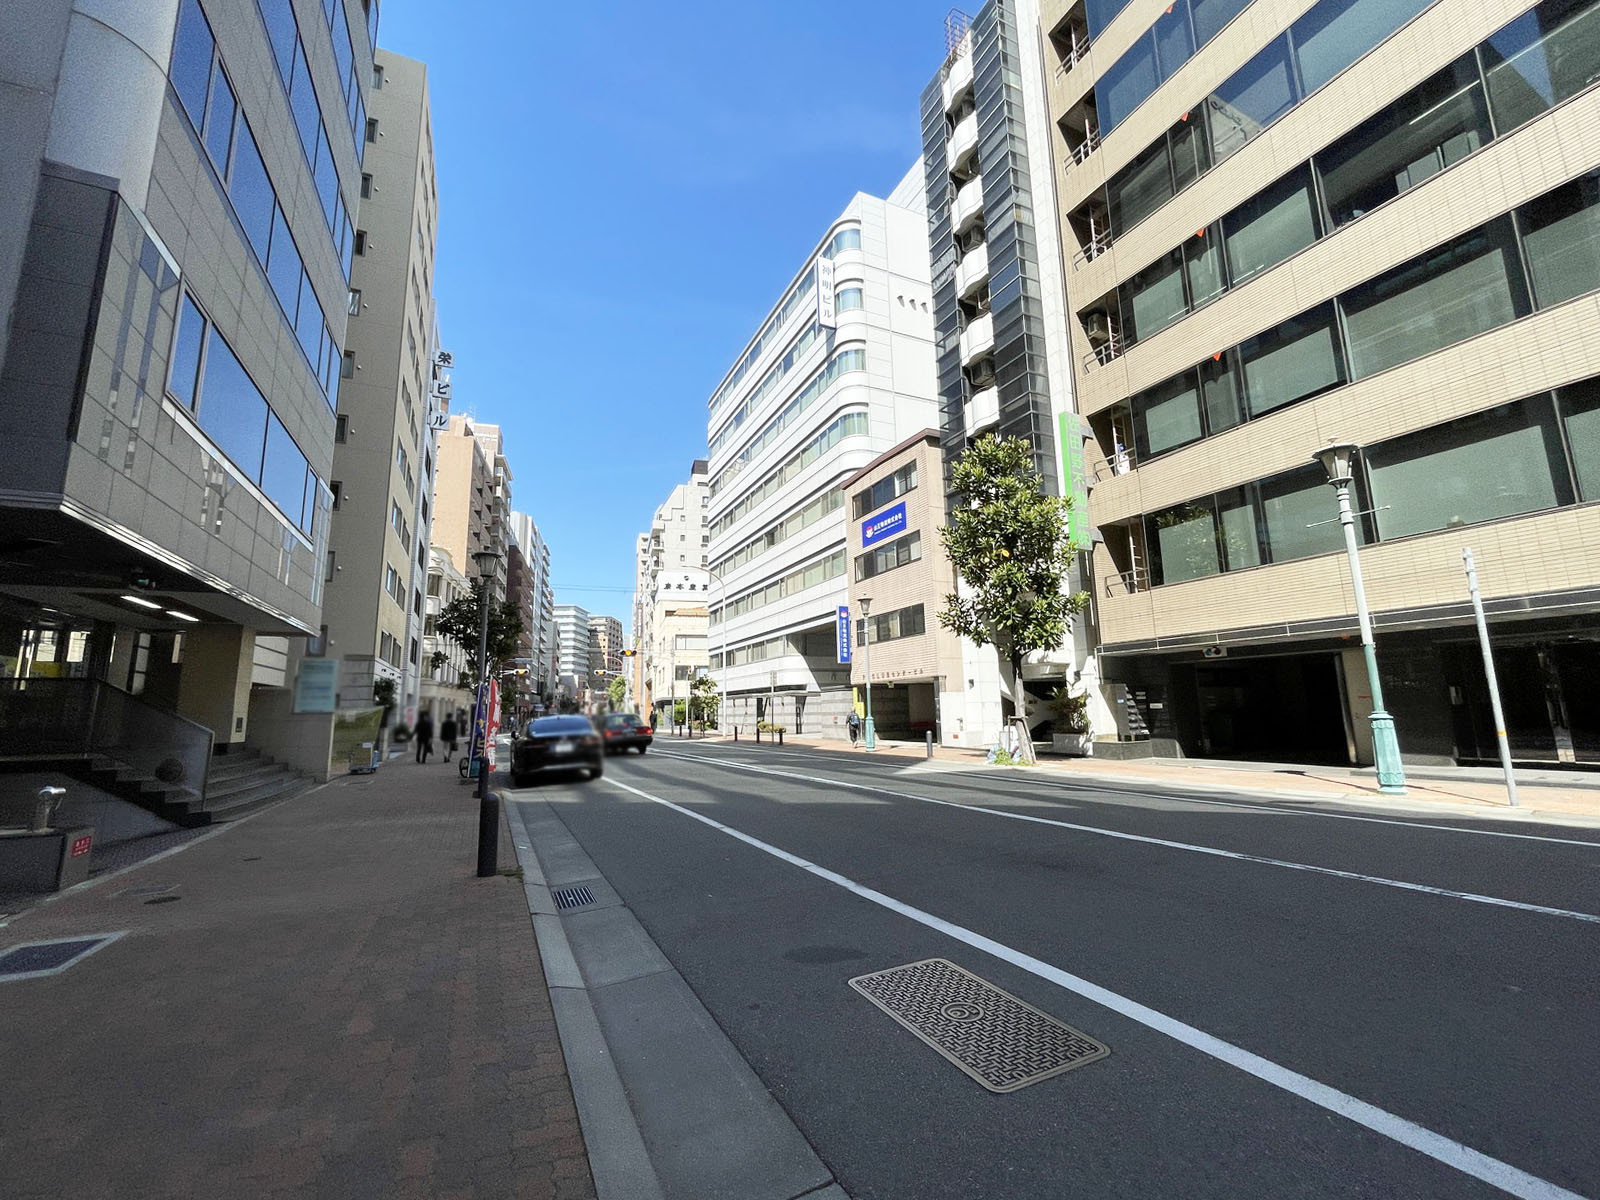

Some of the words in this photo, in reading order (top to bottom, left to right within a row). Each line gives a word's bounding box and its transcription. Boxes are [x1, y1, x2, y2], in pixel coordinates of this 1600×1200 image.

[822, 264, 832, 318] 神明ビル
[432, 351, 452, 427] 栄ビル
